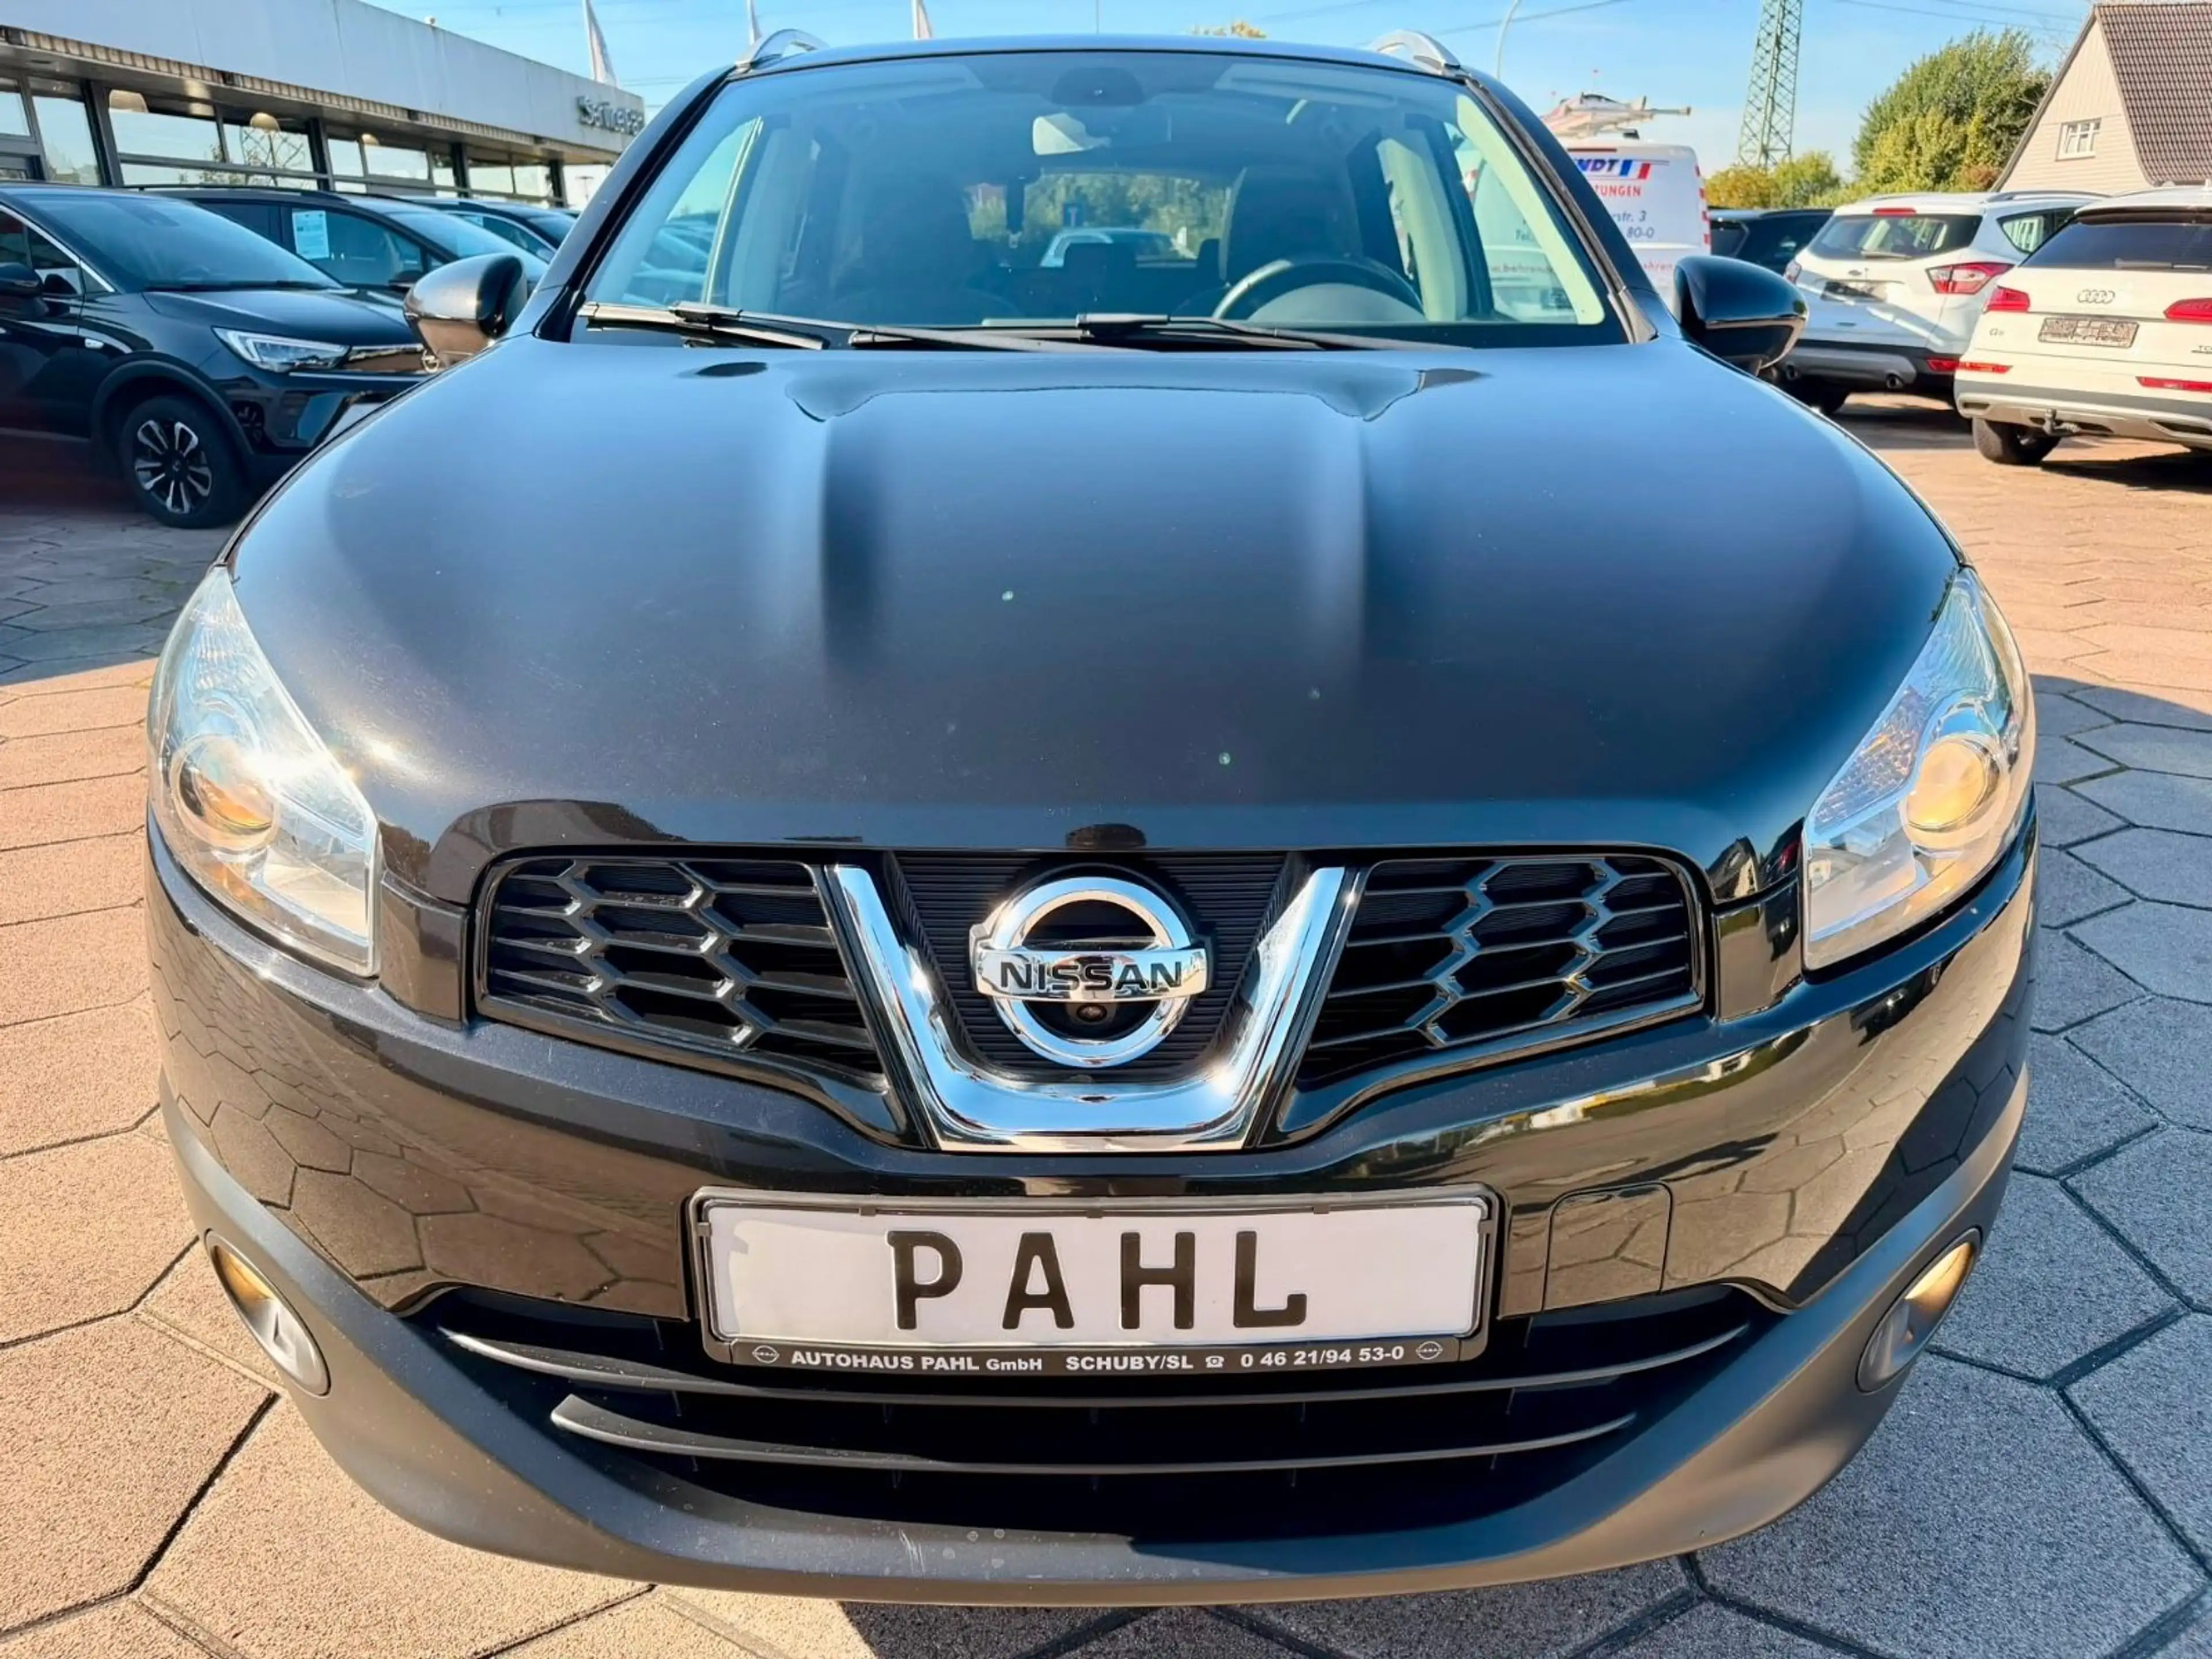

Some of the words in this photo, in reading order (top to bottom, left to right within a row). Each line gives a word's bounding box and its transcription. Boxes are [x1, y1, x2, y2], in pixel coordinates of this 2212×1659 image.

[1639, 210, 1647, 222] 3
[1001, 961, 1183, 991] NISSAN
[887, 1230, 1308, 1330] PAHL
[791, 1350, 914, 1370] AUTOHAUS
[921, 1357, 980, 1370] PAHL
[986, 1358, 1042, 1371] GmbH
[1066, 1355, 1194, 1370] SCHUBY/SL
[1241, 1354, 1253, 1368] 0
[1260, 1352, 1286, 1366] 46
[1294, 1349, 1351, 1365] 21/94
[1358, 1346, 1404, 1362] 53-0
